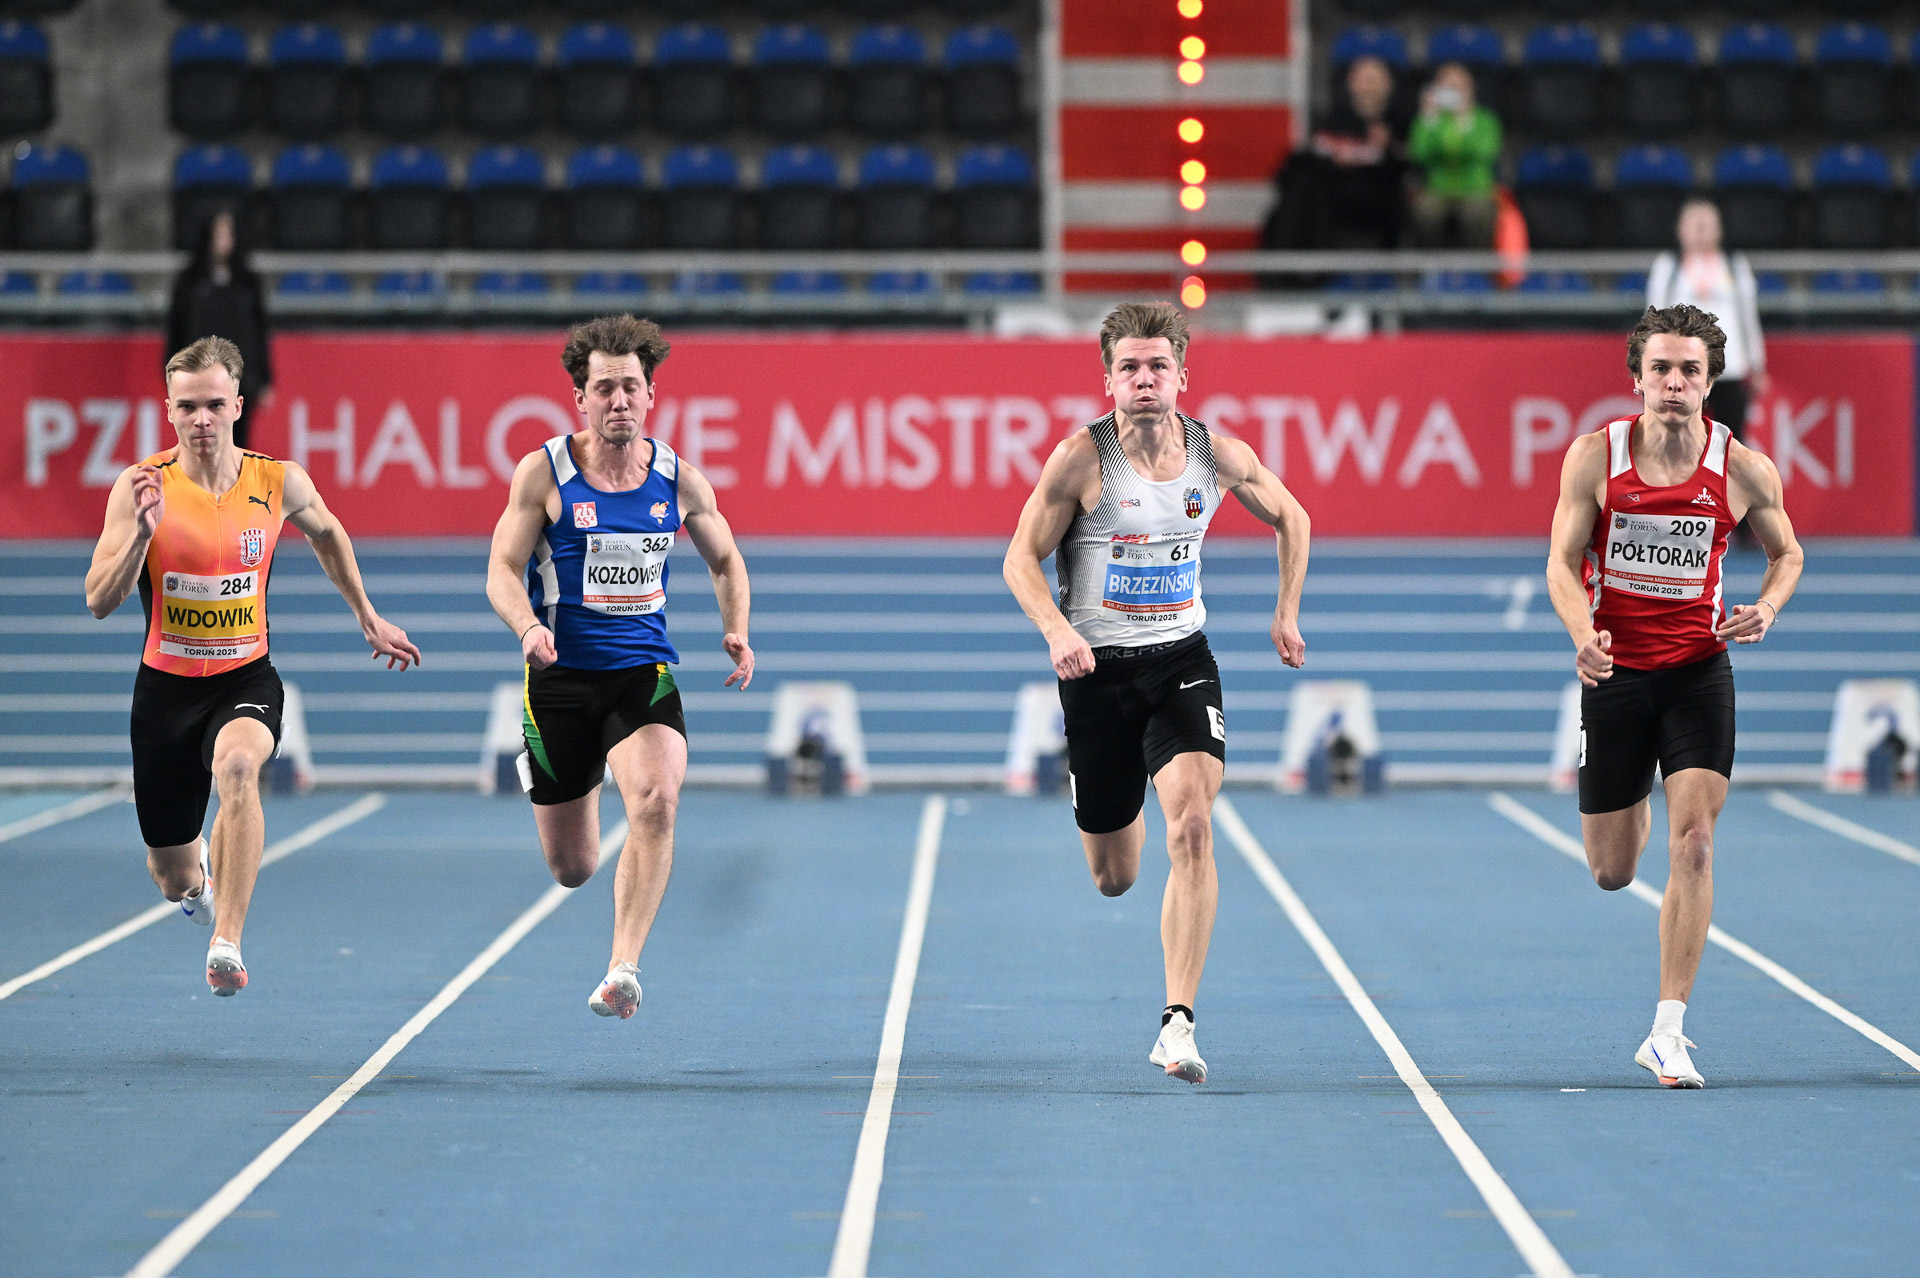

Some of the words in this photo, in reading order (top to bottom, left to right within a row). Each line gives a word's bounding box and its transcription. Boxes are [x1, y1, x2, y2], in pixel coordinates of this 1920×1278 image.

[23, 396, 164, 489] PZ
[287, 395, 740, 490] HALOE
[763, 394, 1482, 490] MISTRSTWA
[1511, 396, 1855, 490] PKI
[1120, 499, 1141, 507] esa
[1618, 494, 1640, 502] sa
[1629, 523, 1658, 532] TORUŃ
[1669, 520, 1706, 537] 209
[604, 542, 631, 551] TORUŃ
[642, 537, 669, 553] 362
[1126, 551, 1154, 560] TORUŃ
[1170, 543, 1189, 561] 61
[1610, 540, 1708, 567] PÓŁTORAK
[181, 584, 209, 593] TORUŃ
[220, 576, 251, 595] 284
[1109, 571, 1194, 595] BRZEZIŃSKI
[1628, 583, 1659, 592] TORUŃ
[1661, 587, 1683, 595] 2025
[606, 604, 633, 612] TORUŃ
[634, 604, 651, 612] 2025
[166, 605, 254, 628] WDOWIK
[1126, 613, 1157, 622] TORUŃ
[1158, 613, 1178, 622] 2025
[184, 647, 215, 656] TORUŃ
[1092, 648, 1135, 660] NIKE
